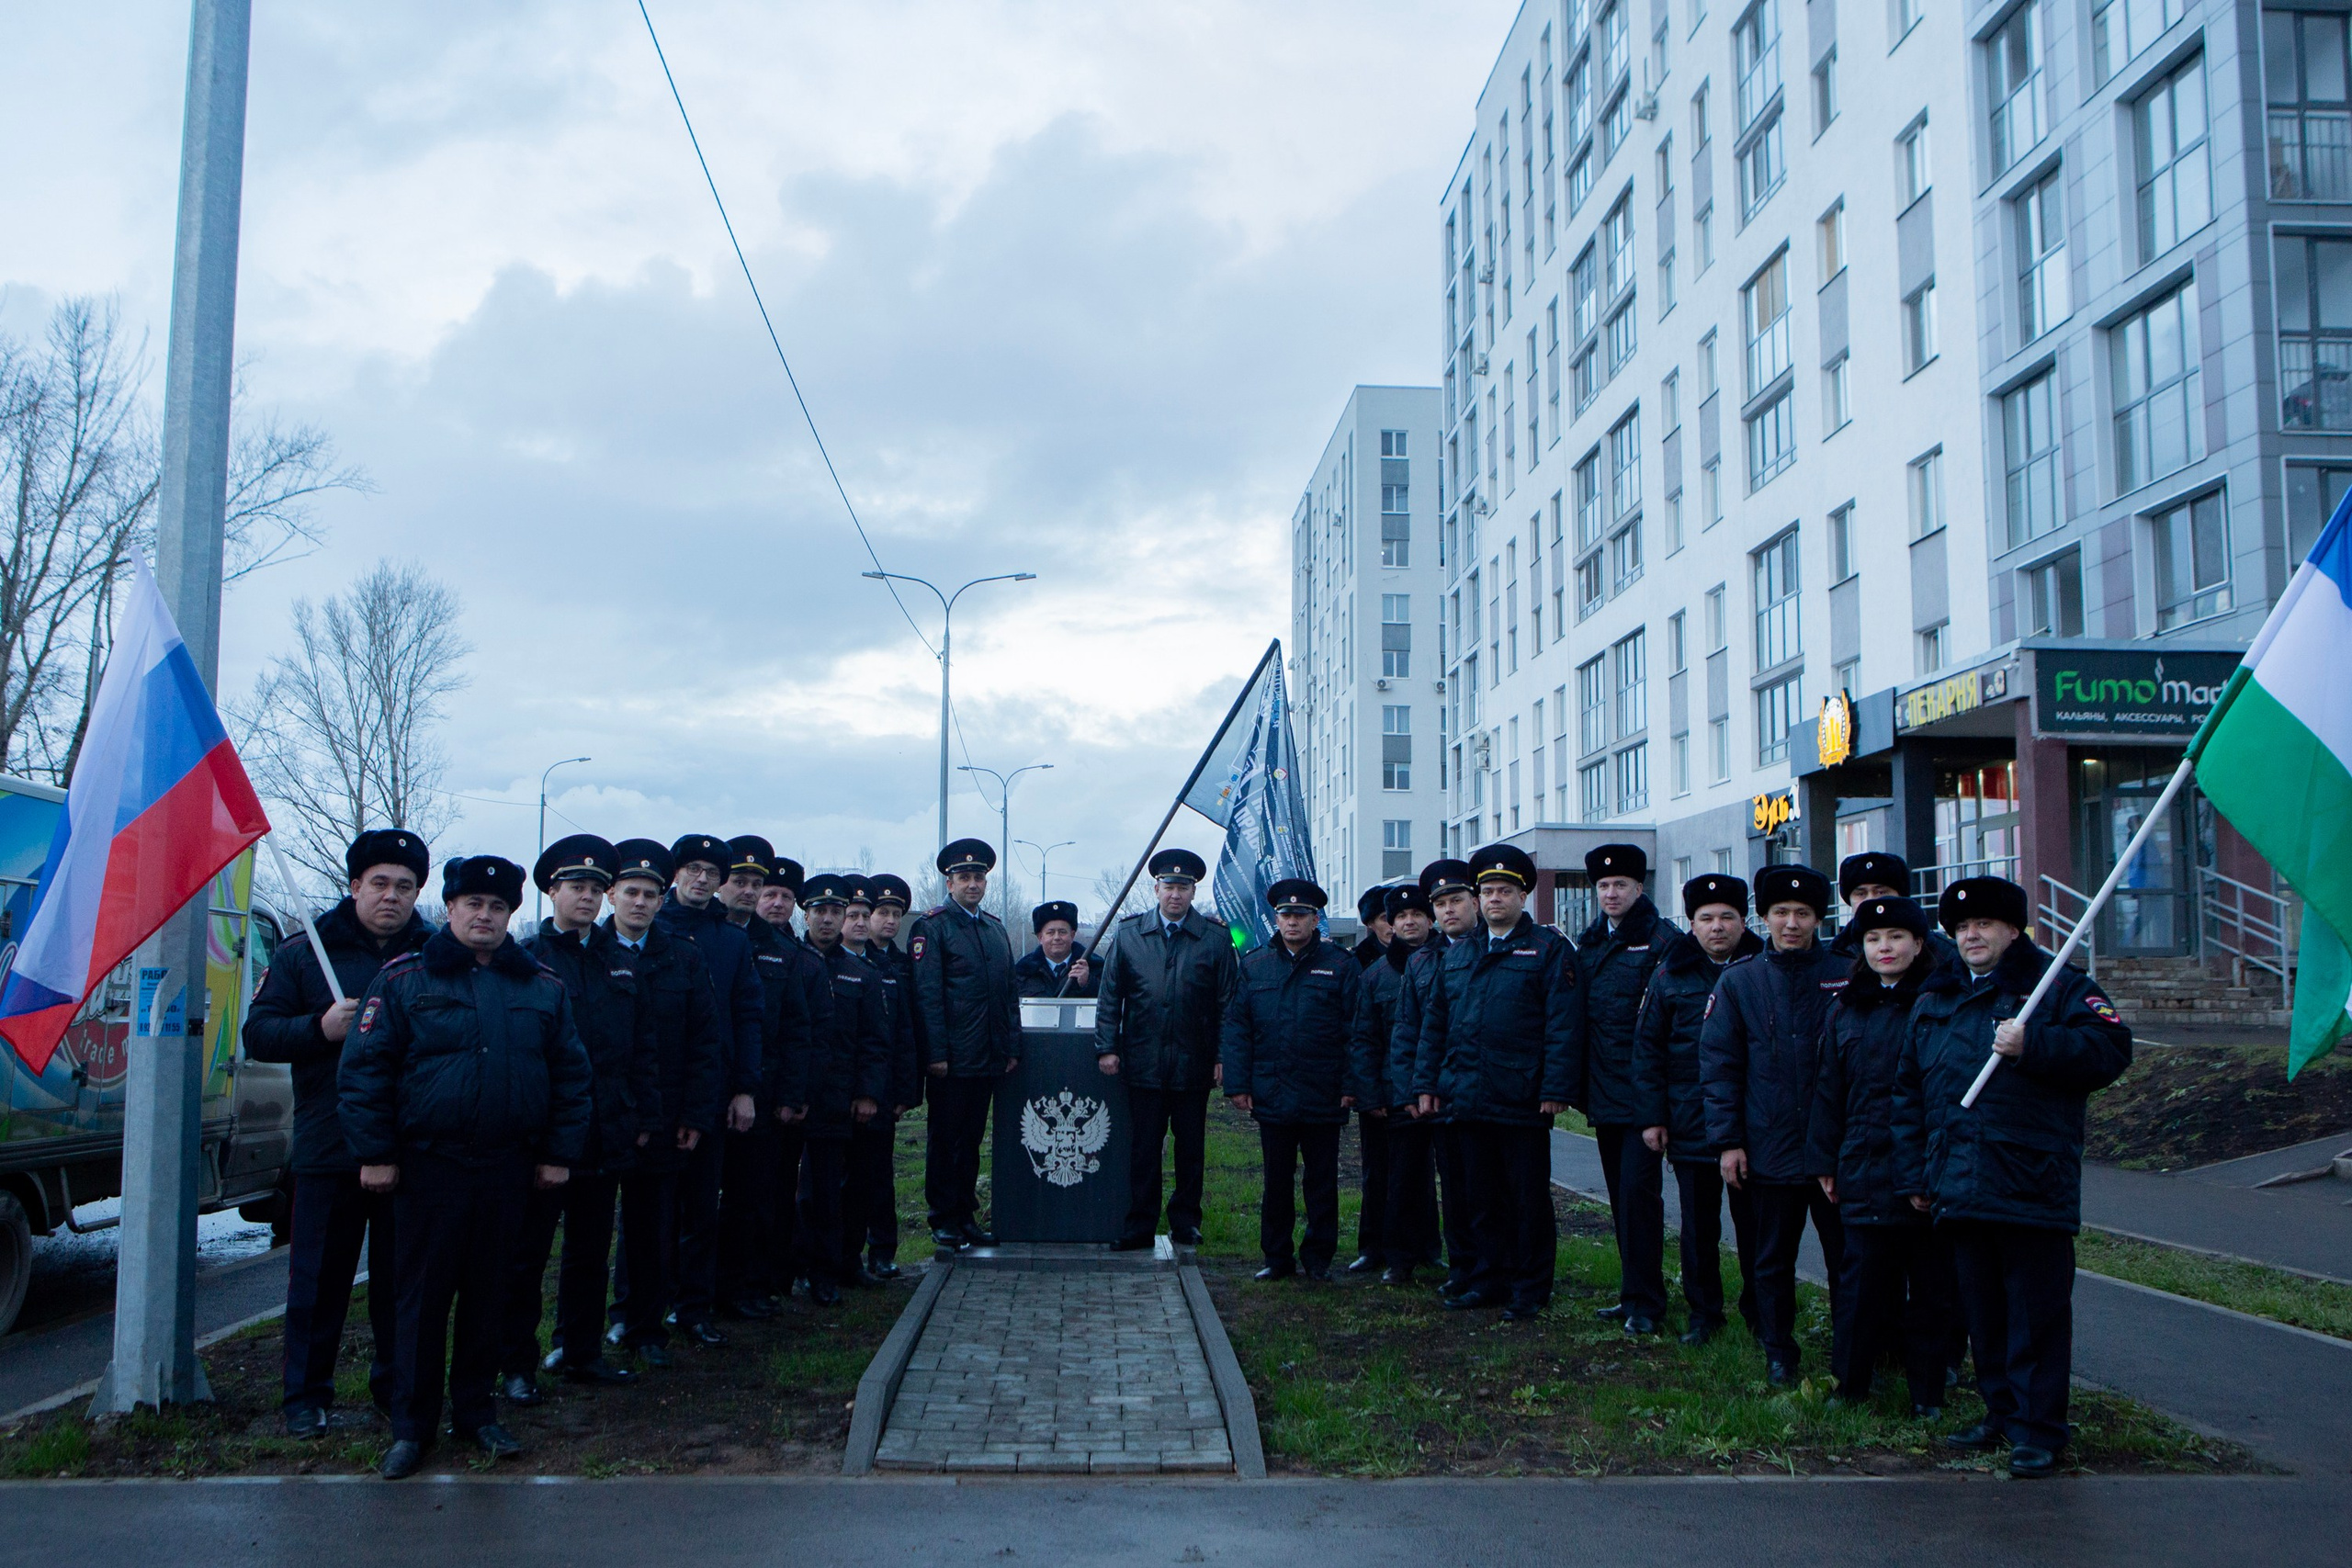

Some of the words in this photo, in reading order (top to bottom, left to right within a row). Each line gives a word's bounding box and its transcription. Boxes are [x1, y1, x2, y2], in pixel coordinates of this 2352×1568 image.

[1908, 671, 1977, 728] ПЕКАРНЯ
[2113, 712, 2186, 725] АКСЕССУАРЫ,
[141, 969, 168, 980] РАБО
[1820, 980, 1849, 988] ПОЛИЦИЯ
